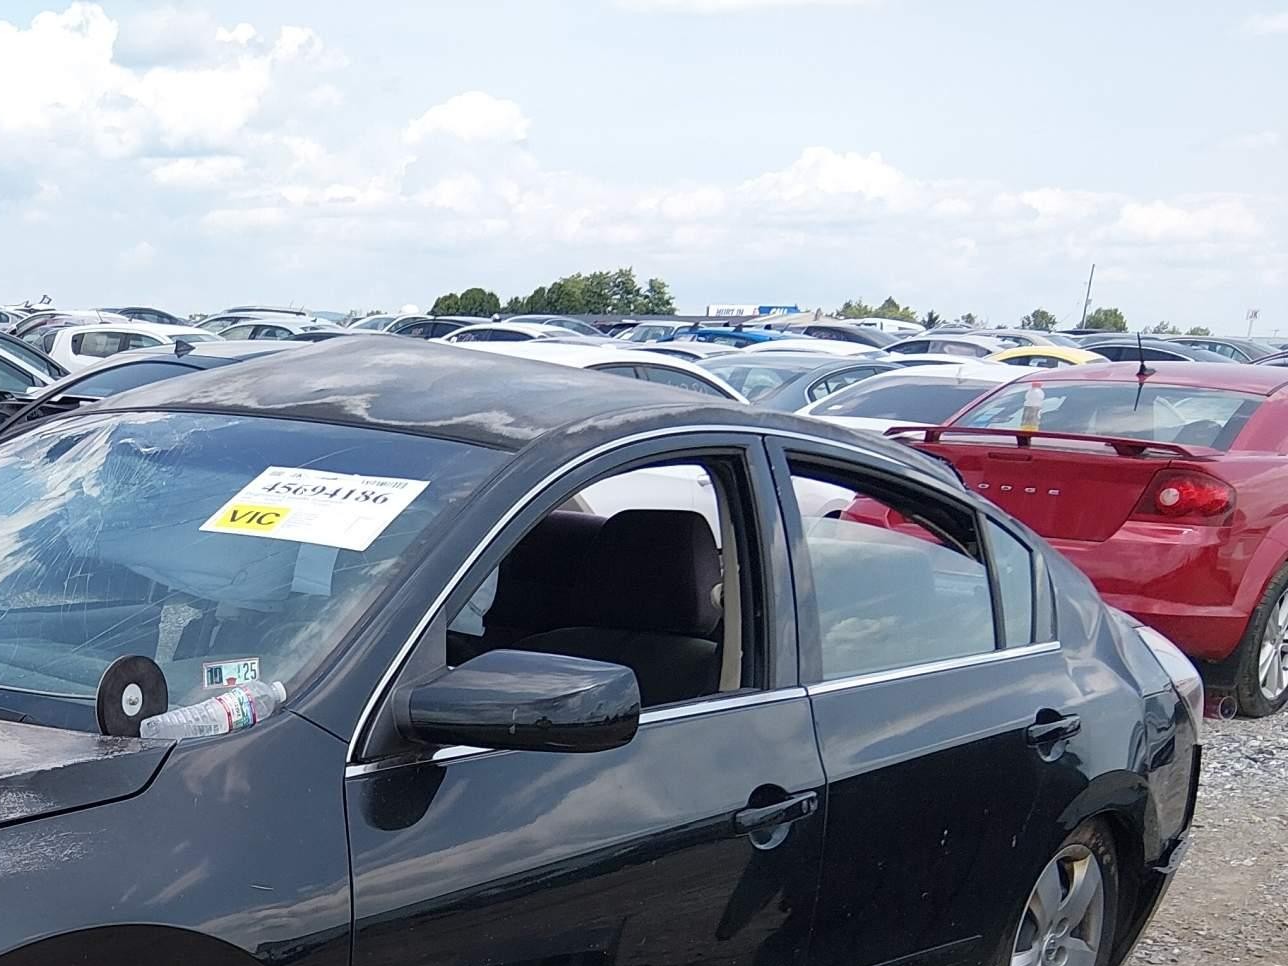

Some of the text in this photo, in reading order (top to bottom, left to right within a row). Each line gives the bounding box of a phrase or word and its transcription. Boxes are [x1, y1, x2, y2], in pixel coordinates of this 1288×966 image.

[261, 480, 393, 506] 45694186
[977, 483, 1059, 495] ODGE
[229, 509, 282, 526] VIC
[242, 661, 257, 681] 25
